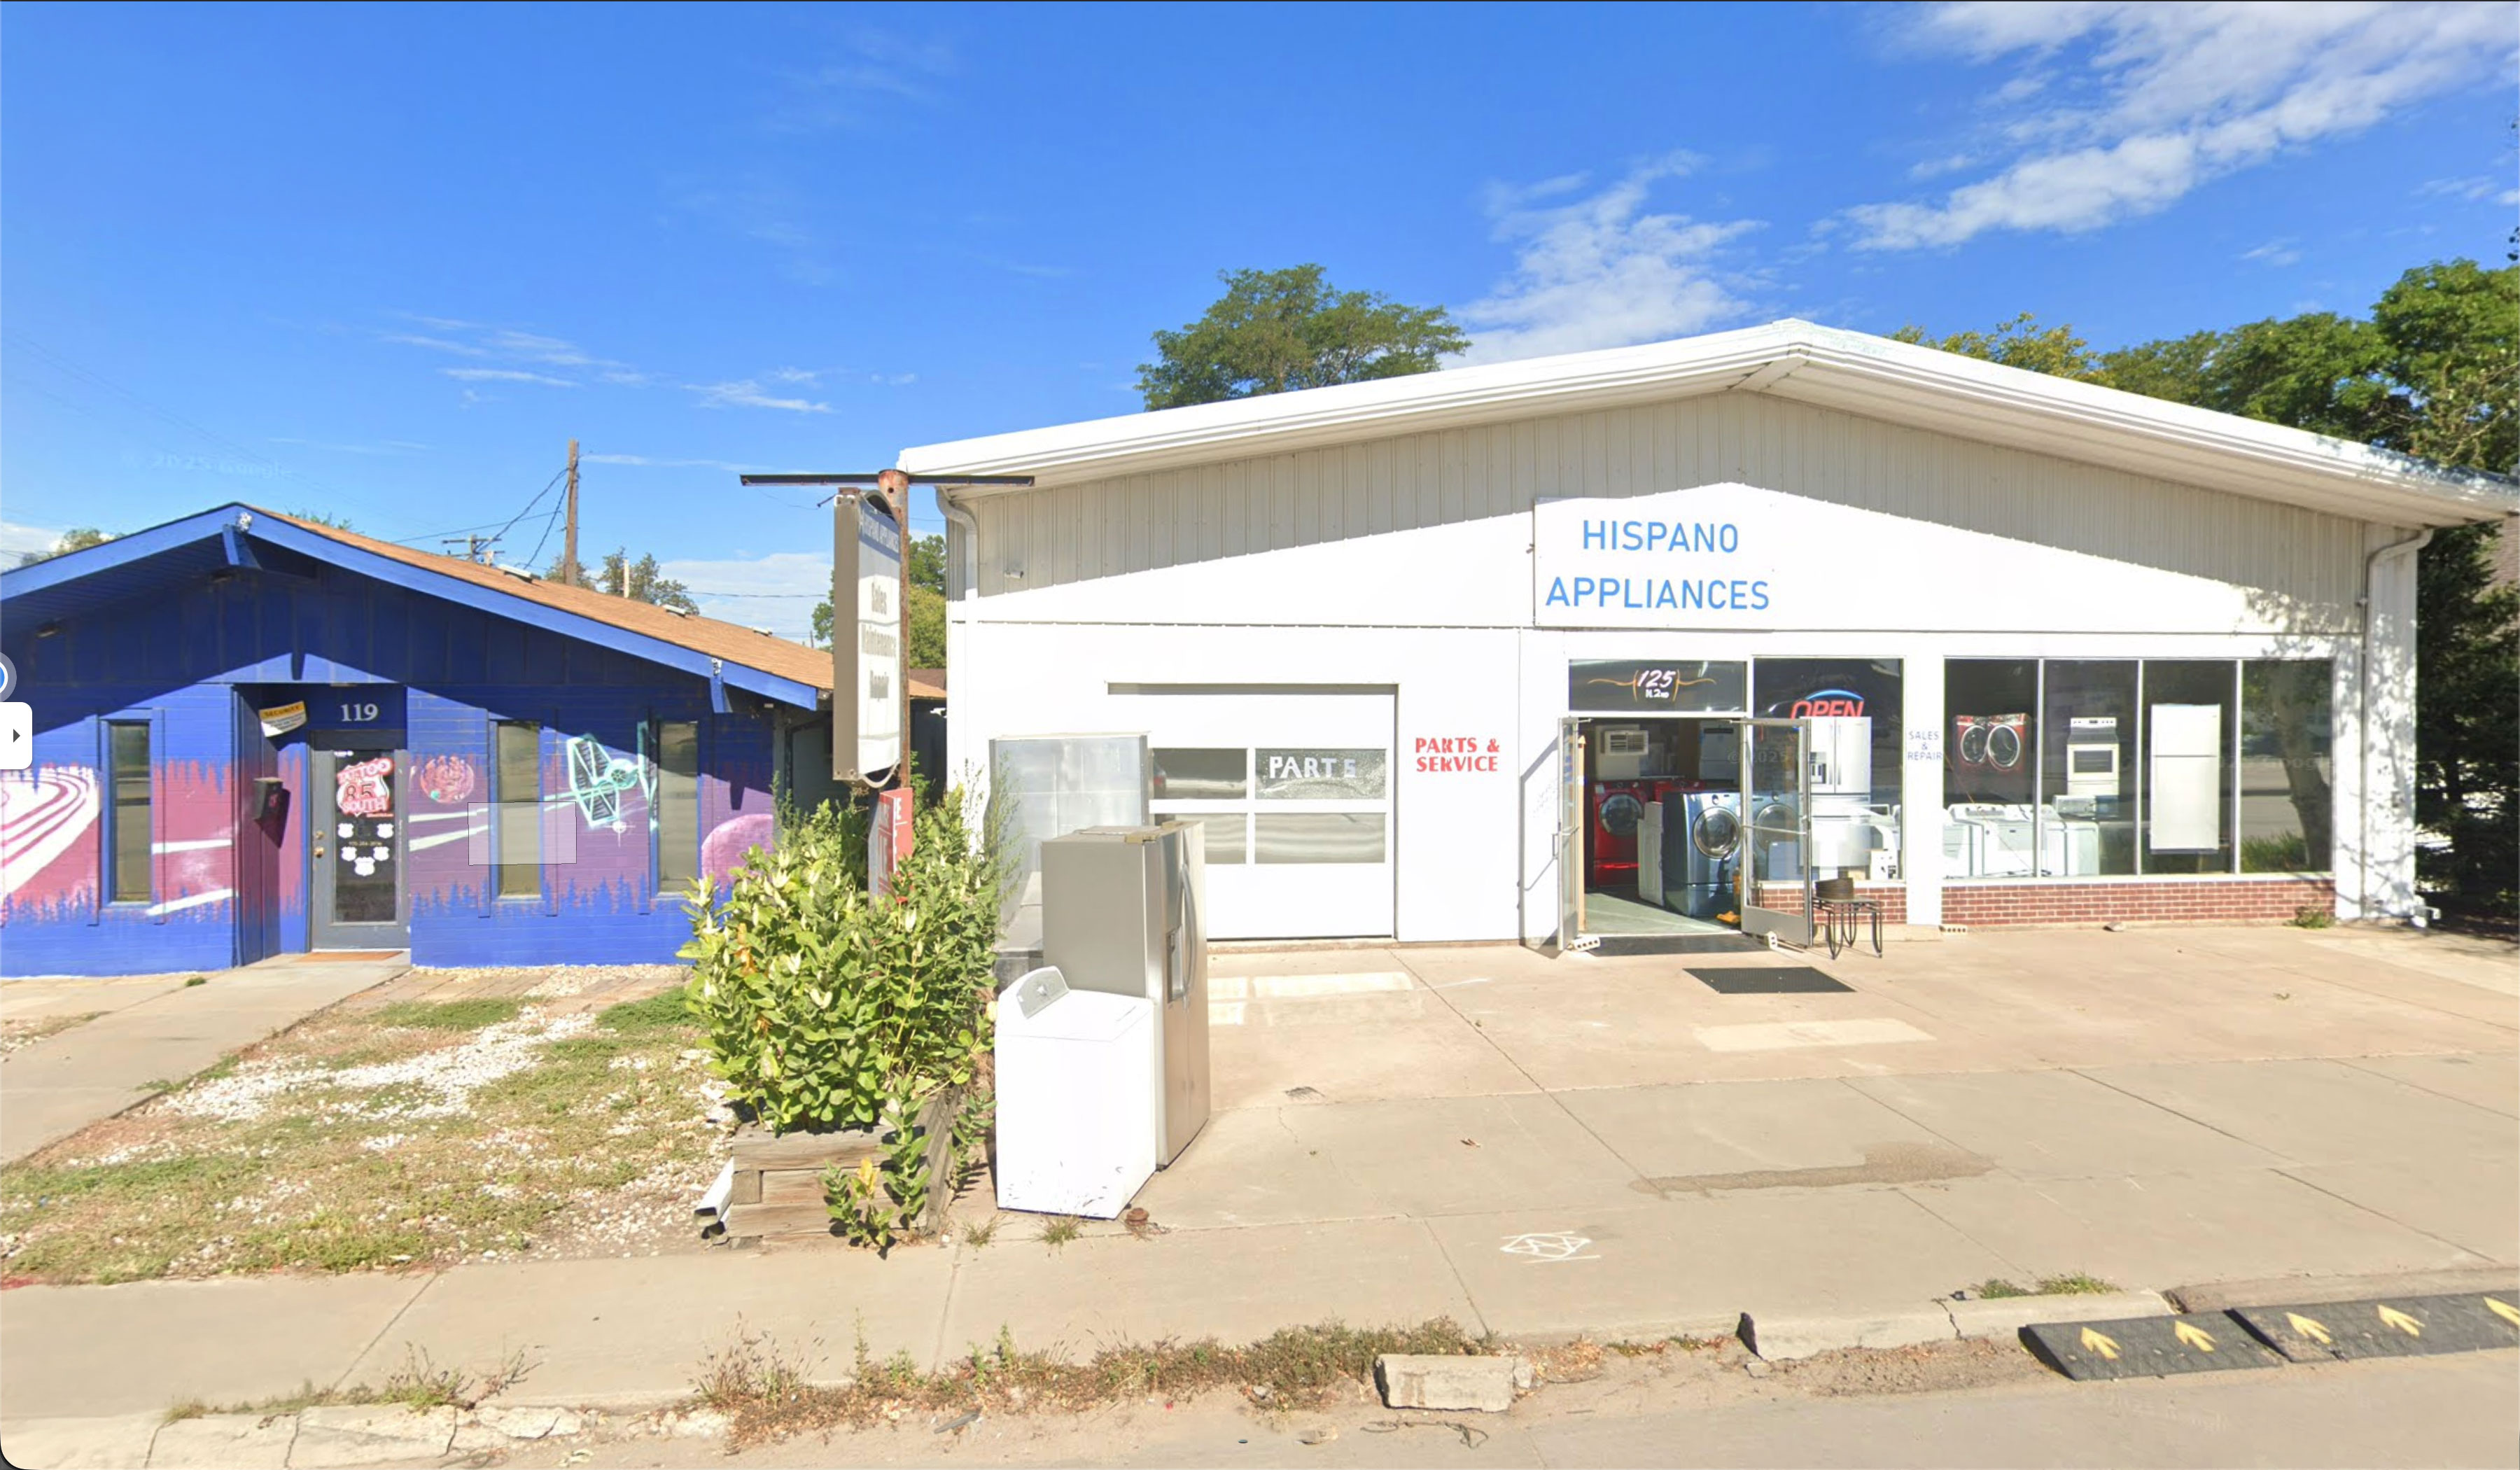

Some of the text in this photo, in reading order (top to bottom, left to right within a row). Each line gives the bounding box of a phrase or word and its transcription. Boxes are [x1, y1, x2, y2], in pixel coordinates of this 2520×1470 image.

[1583, 520, 1739, 553] HISPANO
[1546, 576, 1770, 610] APPLIANCES
[1637, 669, 1676, 688] 125
[341, 704, 379, 722] 119
[1790, 699, 1865, 720] OPEN
[1908, 731, 1939, 741] SALES
[1415, 737, 1500, 754] PARTS &
[1921, 742, 1928, 750] &
[1416, 756, 1498, 772] SERVICE
[1907, 751, 1942, 761] REPAIR
[337, 758, 394, 785] TATTOO
[344, 782, 375, 801] 85
[342, 797, 389, 814] SOUTH
